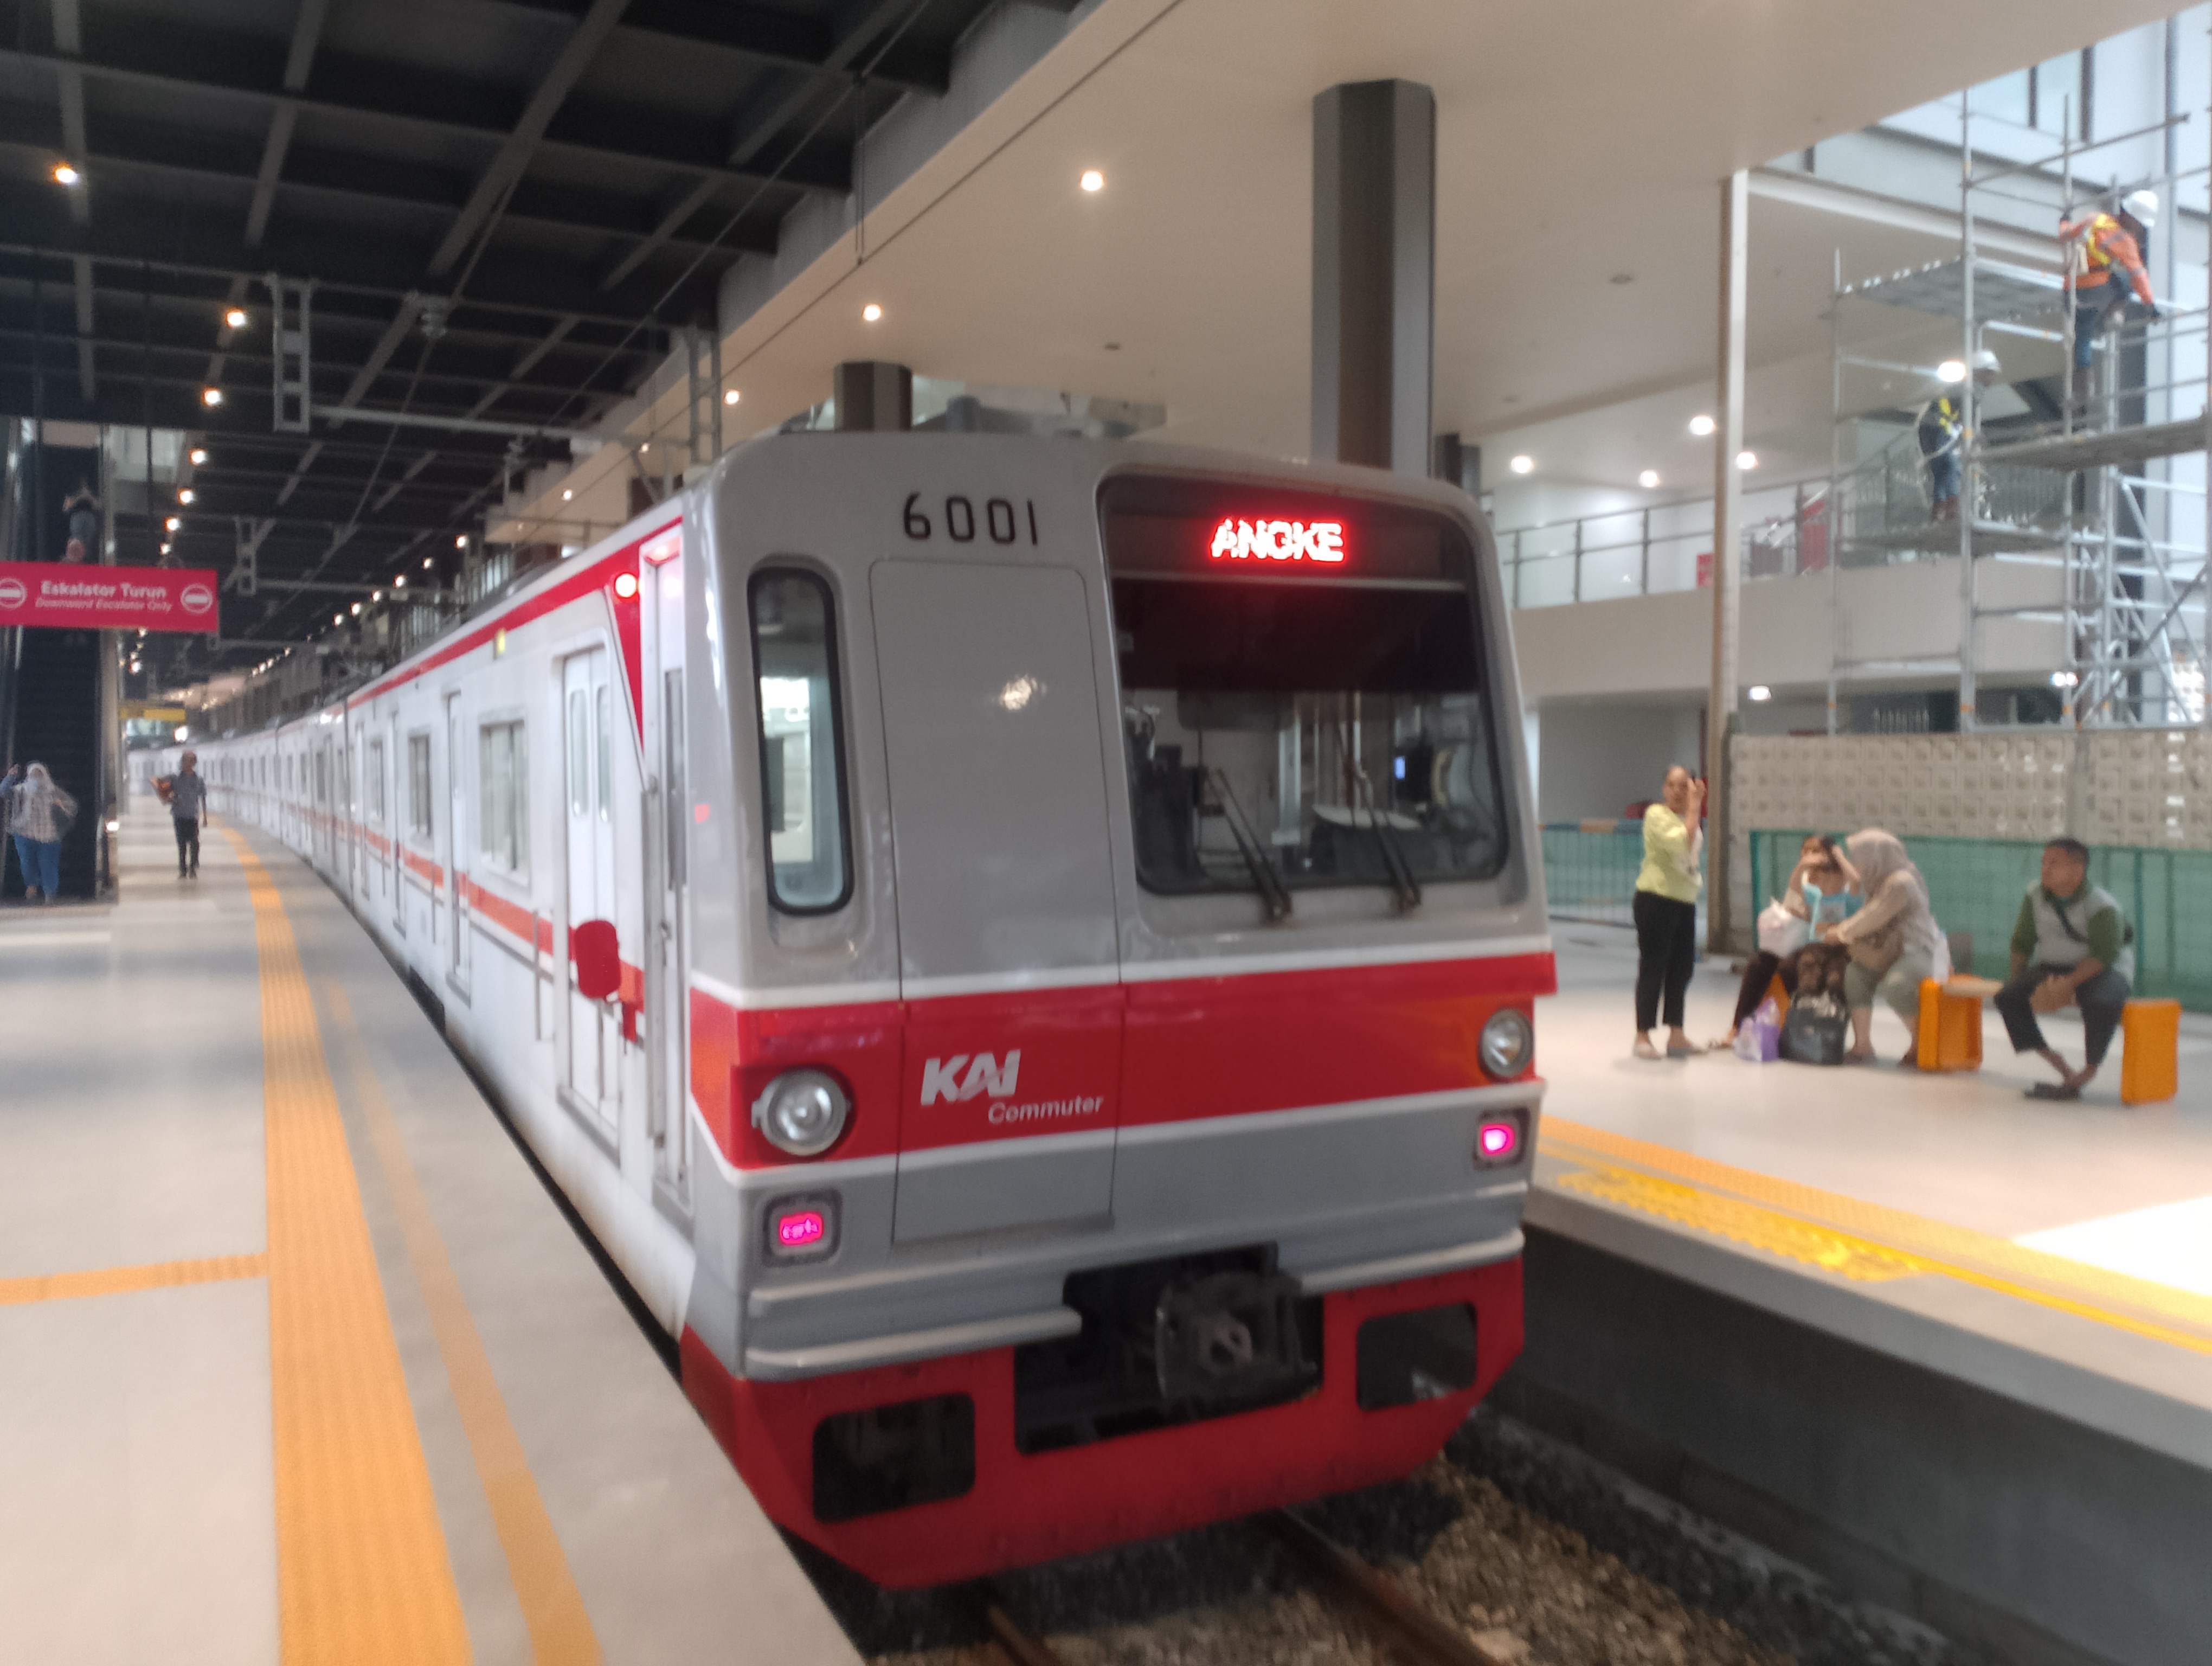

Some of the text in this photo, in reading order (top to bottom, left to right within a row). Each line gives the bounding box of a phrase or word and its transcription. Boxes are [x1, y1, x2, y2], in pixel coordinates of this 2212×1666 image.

[903, 491, 1038, 546] 6001
[1211, 518, 1344, 562] ANGKE
[40, 581, 167, 598] Eskalator Turun
[921, 1049, 1021, 1105] KAI
[988, 1095, 1104, 1124] Commuter
